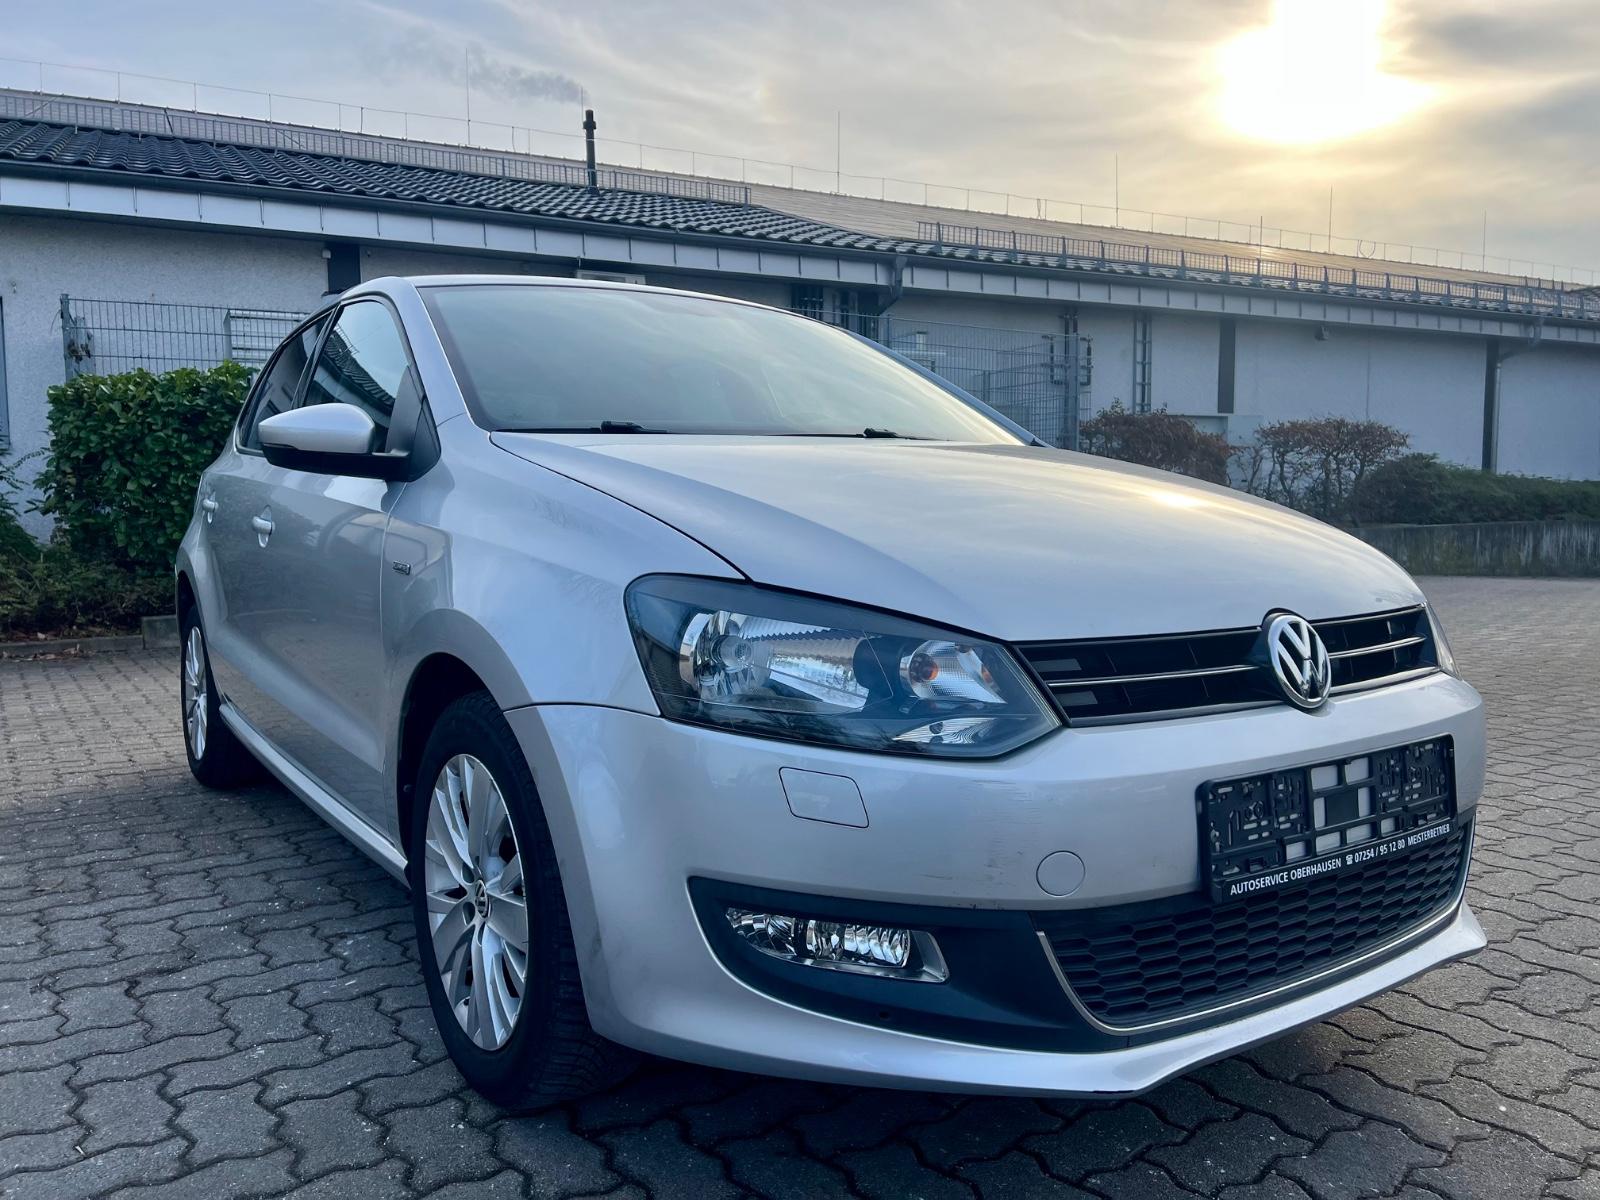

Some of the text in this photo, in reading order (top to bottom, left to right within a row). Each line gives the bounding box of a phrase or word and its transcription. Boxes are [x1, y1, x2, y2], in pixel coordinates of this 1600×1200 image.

[1270, 615, 1330, 703] VW
[1230, 871, 1289, 896] AUTOSERVICE
[1290, 857, 1342, 881] OBERHAUSEN
[1354, 848, 1375, 863] 07254
[1380, 845, 1388, 856] 95
[1389, 841, 1397, 853] 12
[1397, 838, 1406, 850] 80
[1407, 823, 1450, 847] MEISTERBETRIEB
